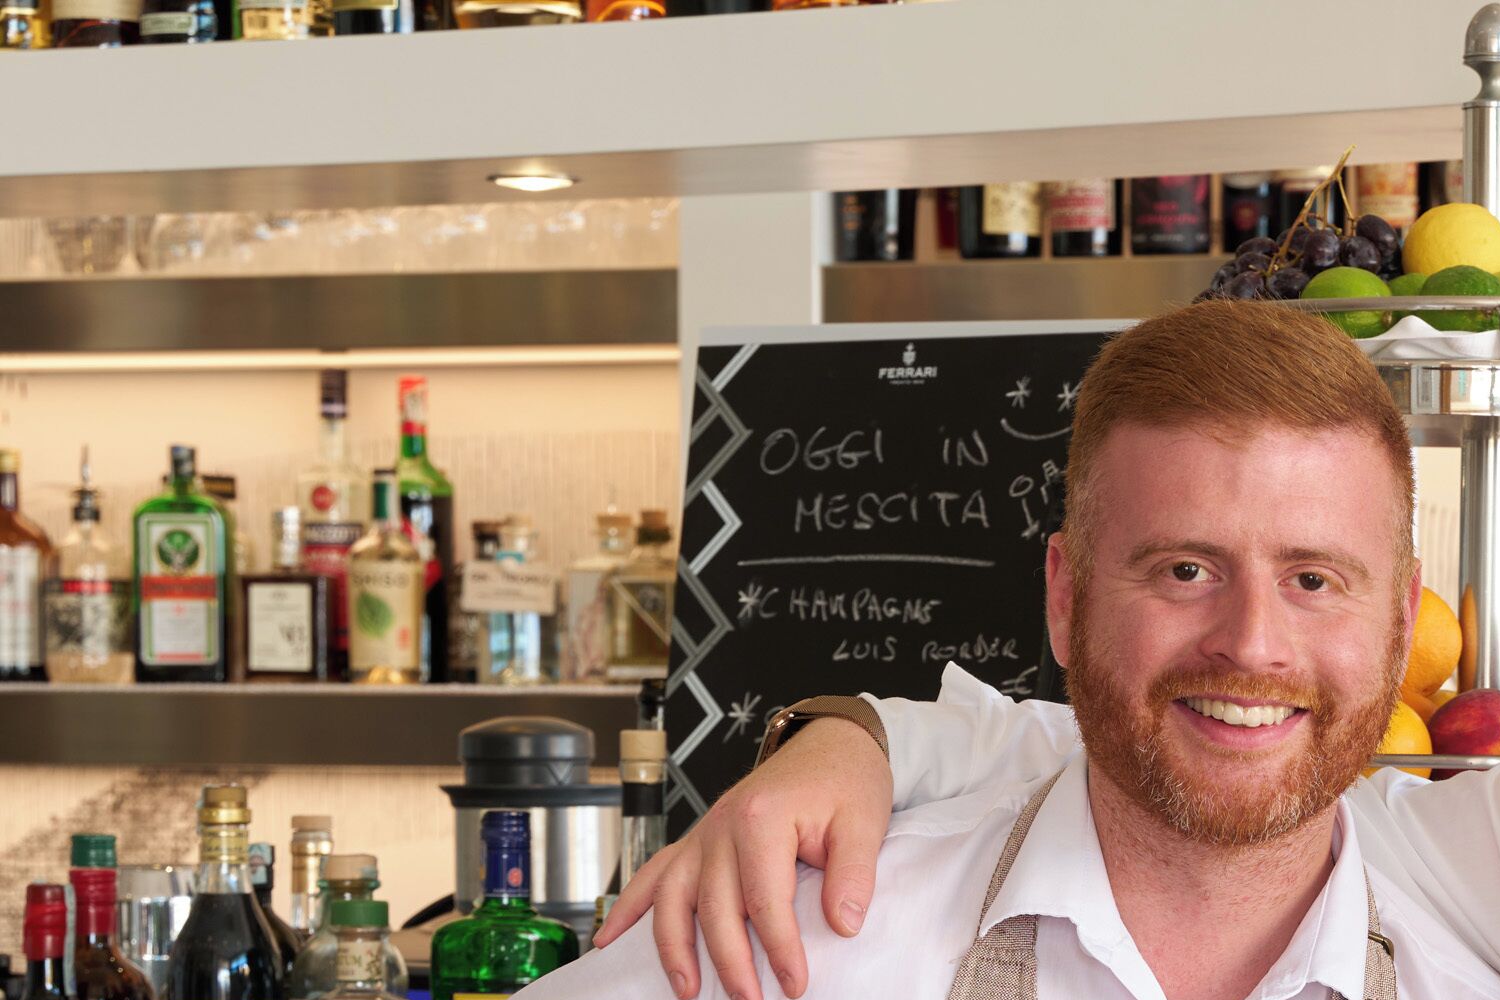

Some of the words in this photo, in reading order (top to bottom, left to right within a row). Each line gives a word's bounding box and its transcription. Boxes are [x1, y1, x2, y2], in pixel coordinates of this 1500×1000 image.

[878, 366, 938, 379] FERRARI
[760, 427, 884, 475] OGGI
[795, 487, 990, 532] MESCITA
[832, 636, 897, 661] LUIS
